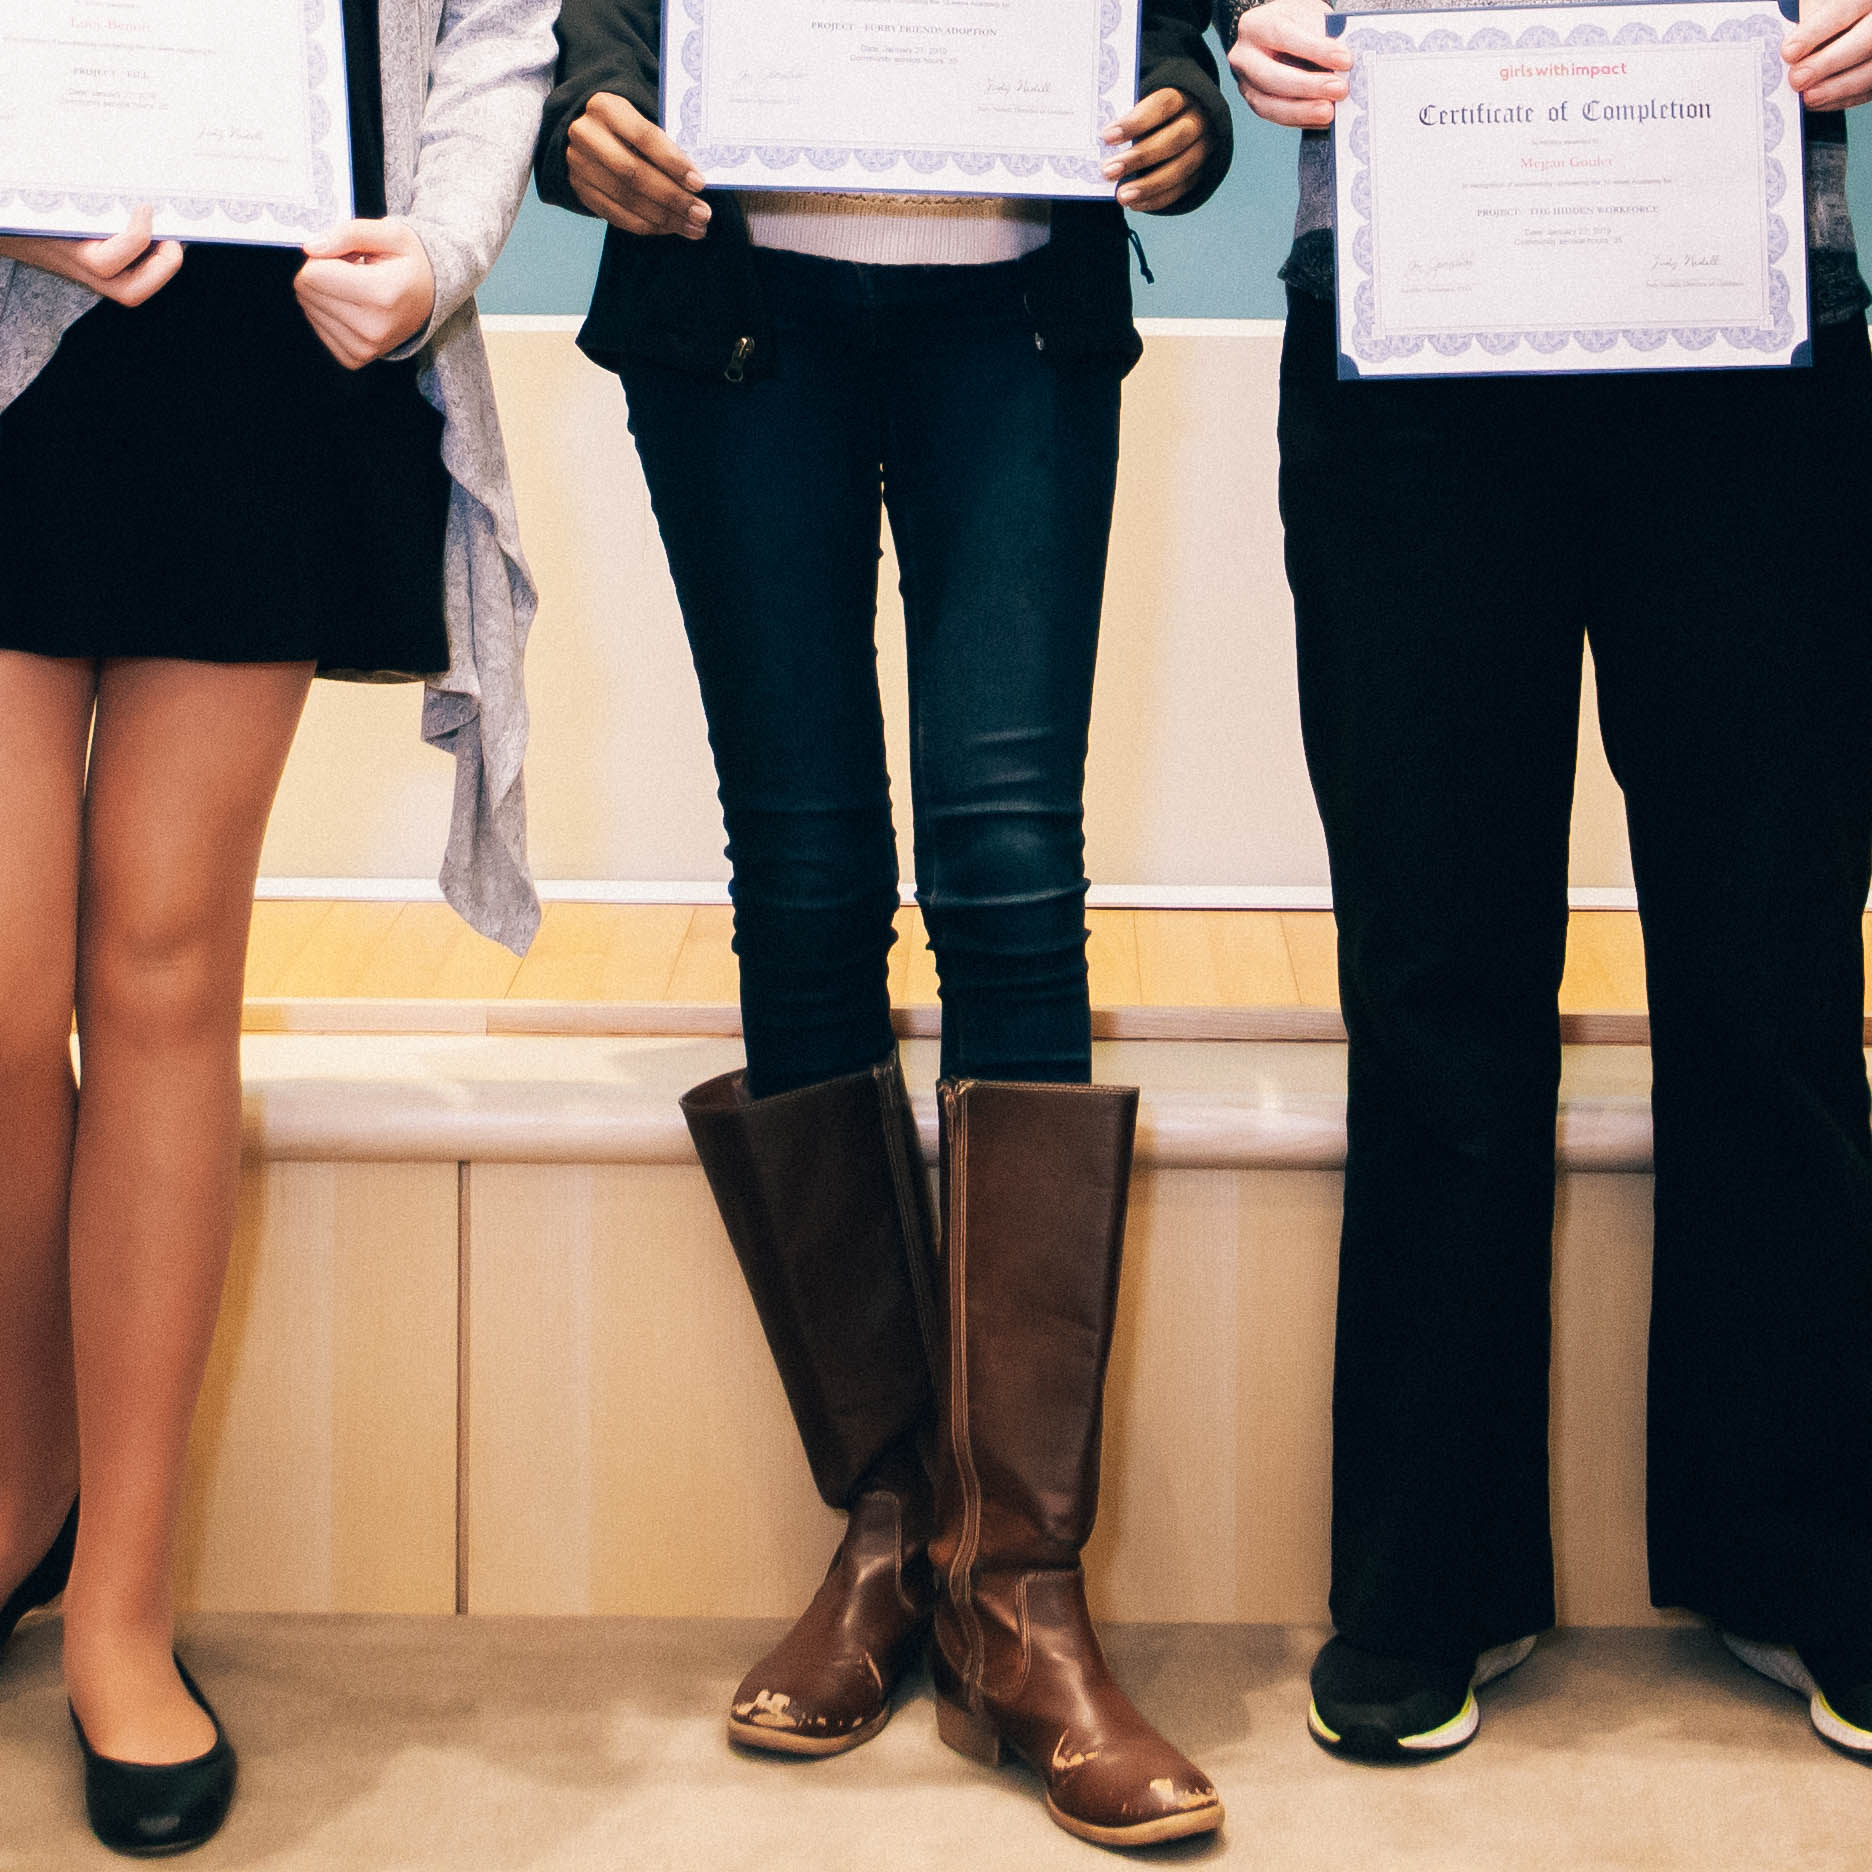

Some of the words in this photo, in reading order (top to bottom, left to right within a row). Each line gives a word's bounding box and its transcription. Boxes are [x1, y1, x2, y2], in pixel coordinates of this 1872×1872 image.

[1418, 104, 1535, 127] Certificate
[1548, 102, 1570, 124] of
[1582, 99, 1713, 125] Completion
[1519, 157, 1566, 171] Megan
